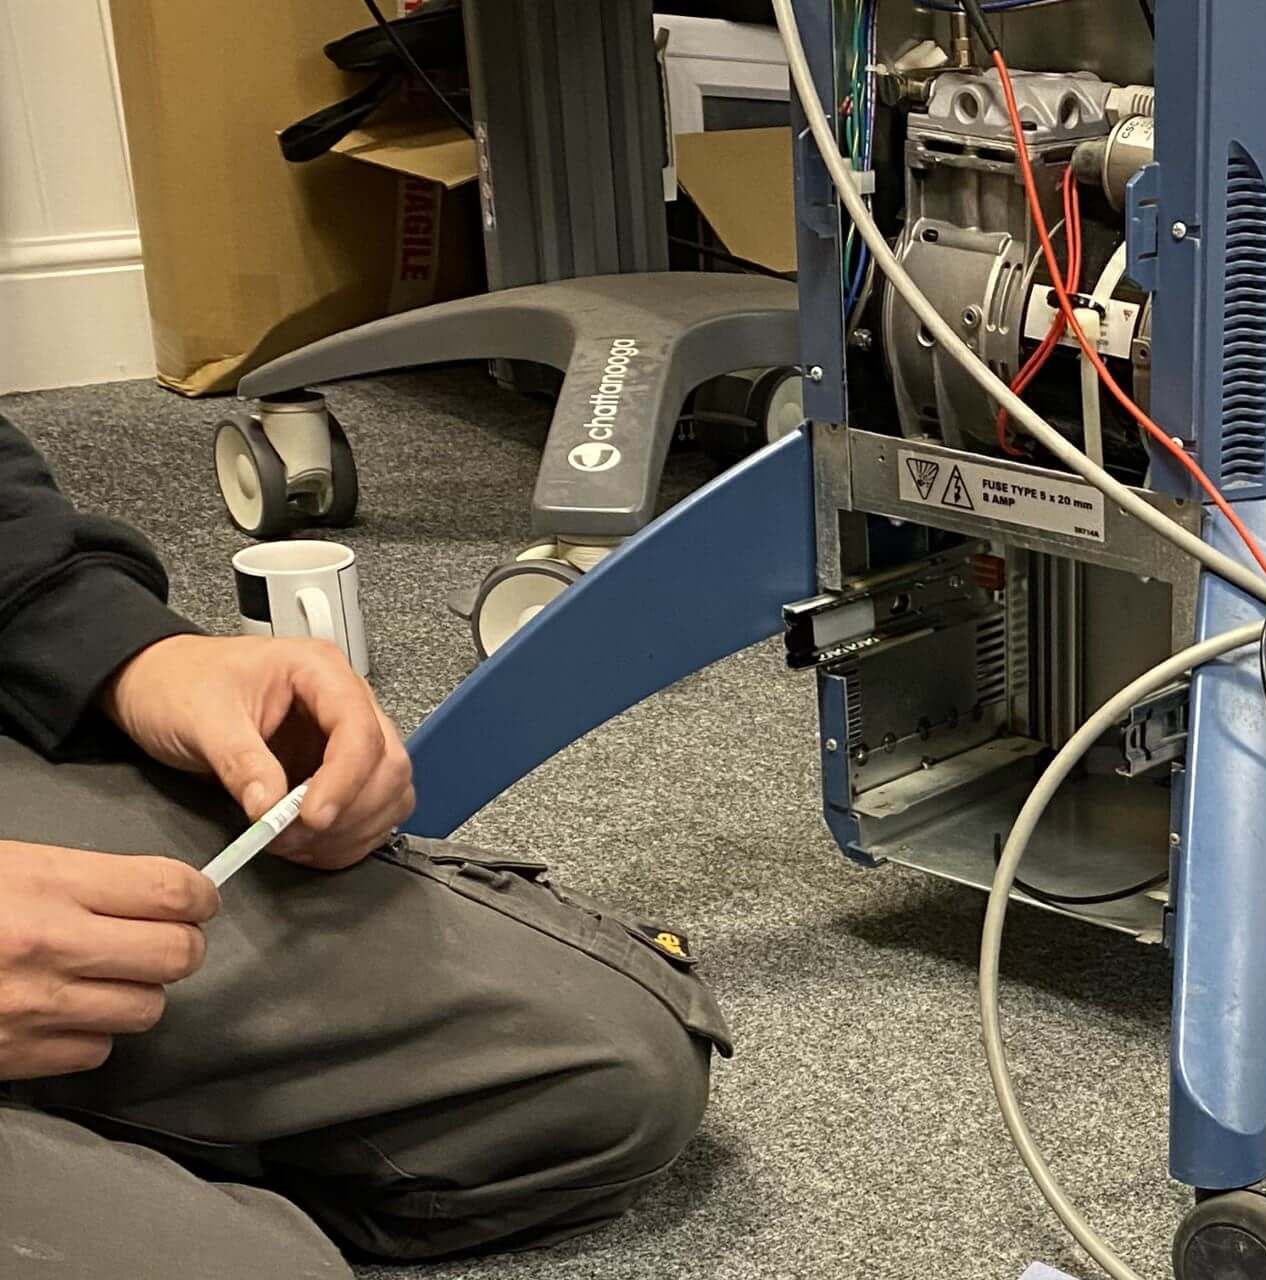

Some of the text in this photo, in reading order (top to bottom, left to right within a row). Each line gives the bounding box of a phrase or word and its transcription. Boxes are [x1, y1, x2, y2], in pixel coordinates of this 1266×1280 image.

[402, 175, 433, 281] RAGILE
[583, 339, 639, 440] chattanooga
[982, 479, 1008, 494] FUSE
[1011, 485, 1037, 500] TYPE
[1058, 495, 1071, 506] 20
[1073, 500, 1093, 511] mm
[992, 495, 1016, 507] AMP
